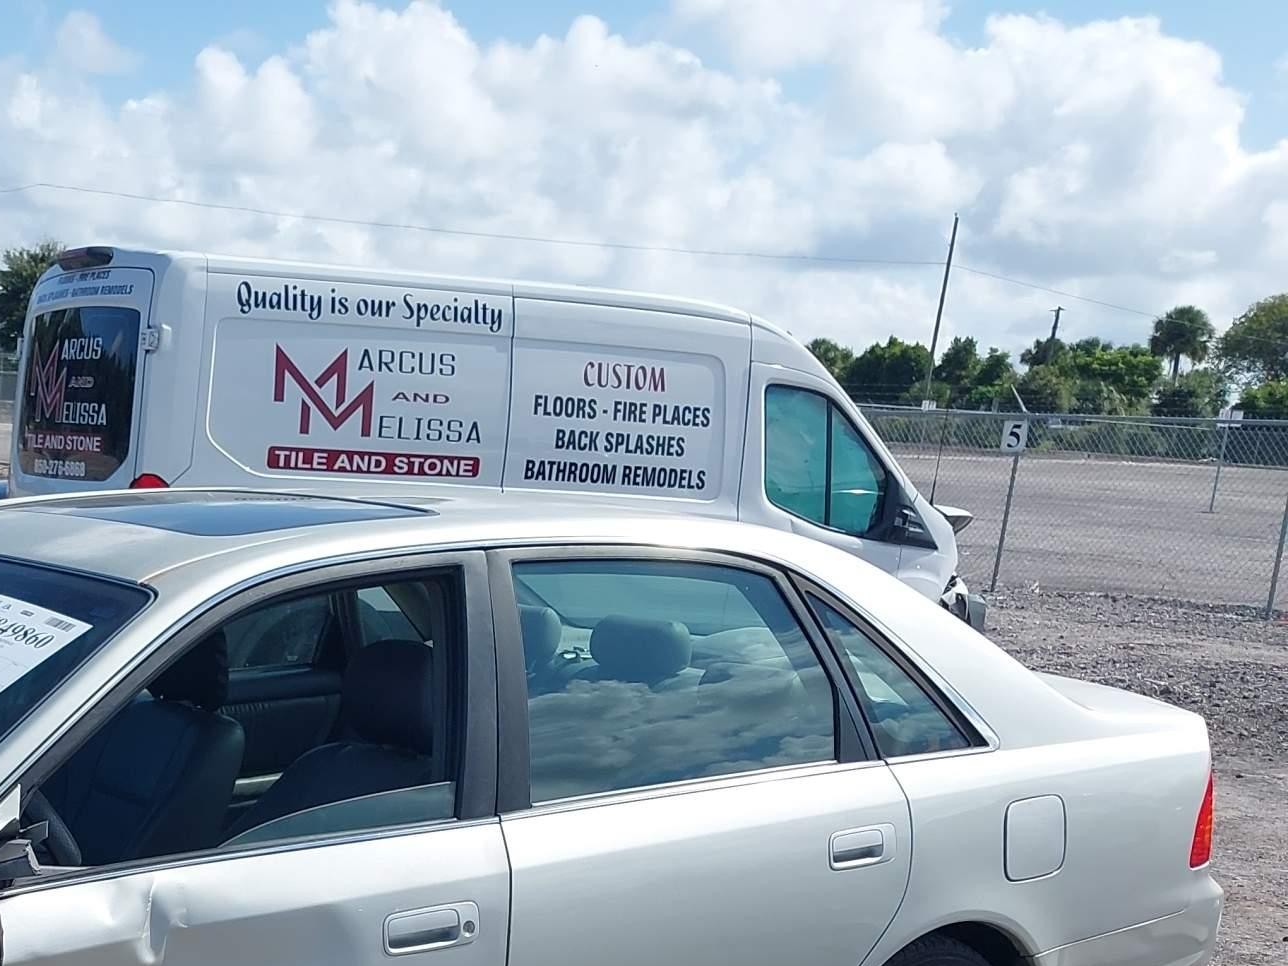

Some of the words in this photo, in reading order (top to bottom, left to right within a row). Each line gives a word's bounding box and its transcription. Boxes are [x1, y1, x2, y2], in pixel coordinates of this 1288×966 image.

[237, 280, 323, 321] Quality
[330, 288, 349, 315] is
[356, 298, 396, 318] our
[402, 293, 503, 333] Specialty
[584, 361, 666, 393] CUSTOM
[392, 391, 450, 404] AND
[534, 394, 598, 420] FLOORS
[613, 400, 647, 424] FIRE
[652, 403, 711, 428] PLACES
[65, 435, 102, 452] STONE
[555, 428, 600, 453] BACK
[604, 431, 685, 458] SPLASHES
[1006, 424, 1022, 448] 5
[274, 450, 328, 471] TILE
[333, 453, 387, 473] AND
[393, 455, 474, 477] STONE
[524, 459, 617, 485] BATHROOM
[621, 464, 706, 491] REMODELS
